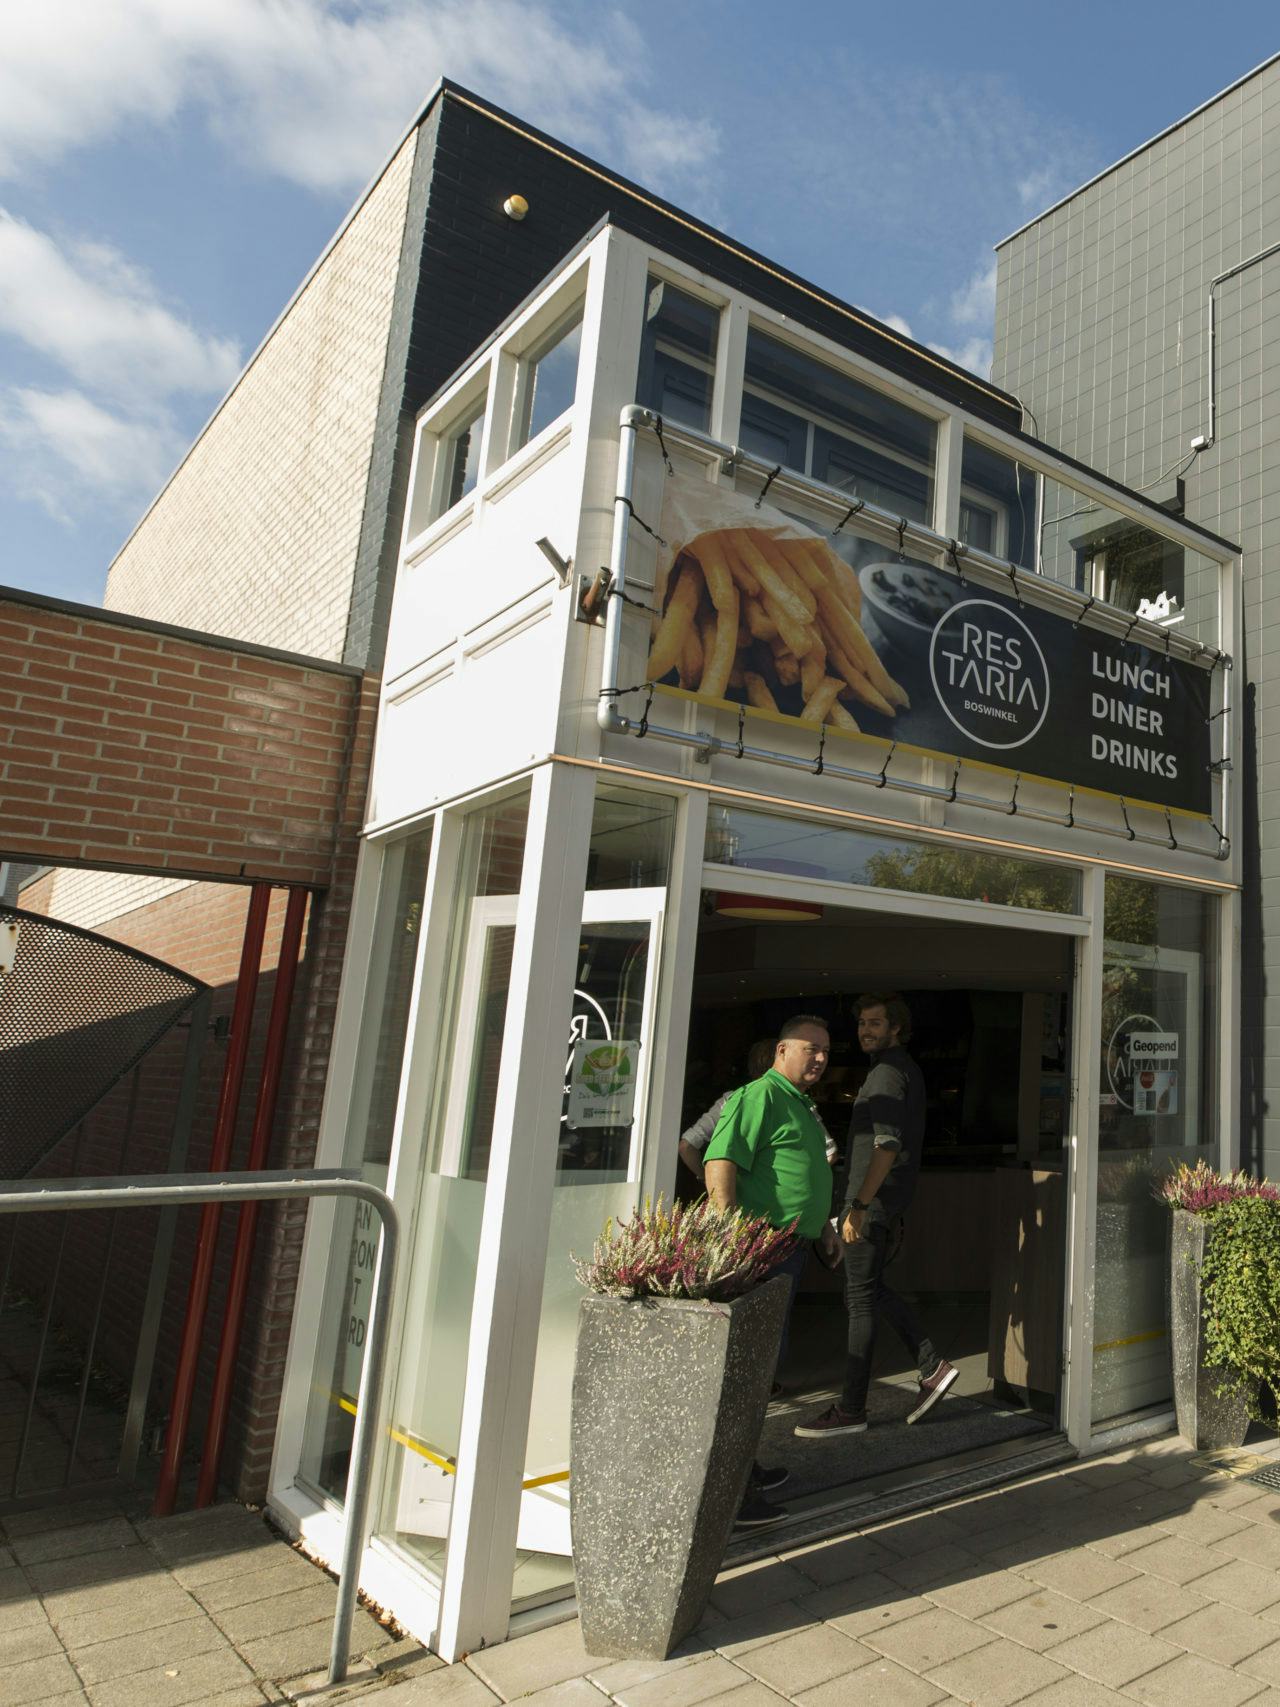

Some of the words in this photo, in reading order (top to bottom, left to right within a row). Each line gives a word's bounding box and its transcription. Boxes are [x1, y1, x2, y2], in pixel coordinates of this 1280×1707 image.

[962, 622, 1021, 671] RES
[942, 650, 1038, 711] TARIA
[1092, 651, 1170, 699] LUNCH
[964, 699, 1018, 724] BOSWINKEL
[1091, 692, 1164, 736] DINER
[1091, 734, 1178, 780] DRINKS
[1133, 1040, 1177, 1054] Geopend
